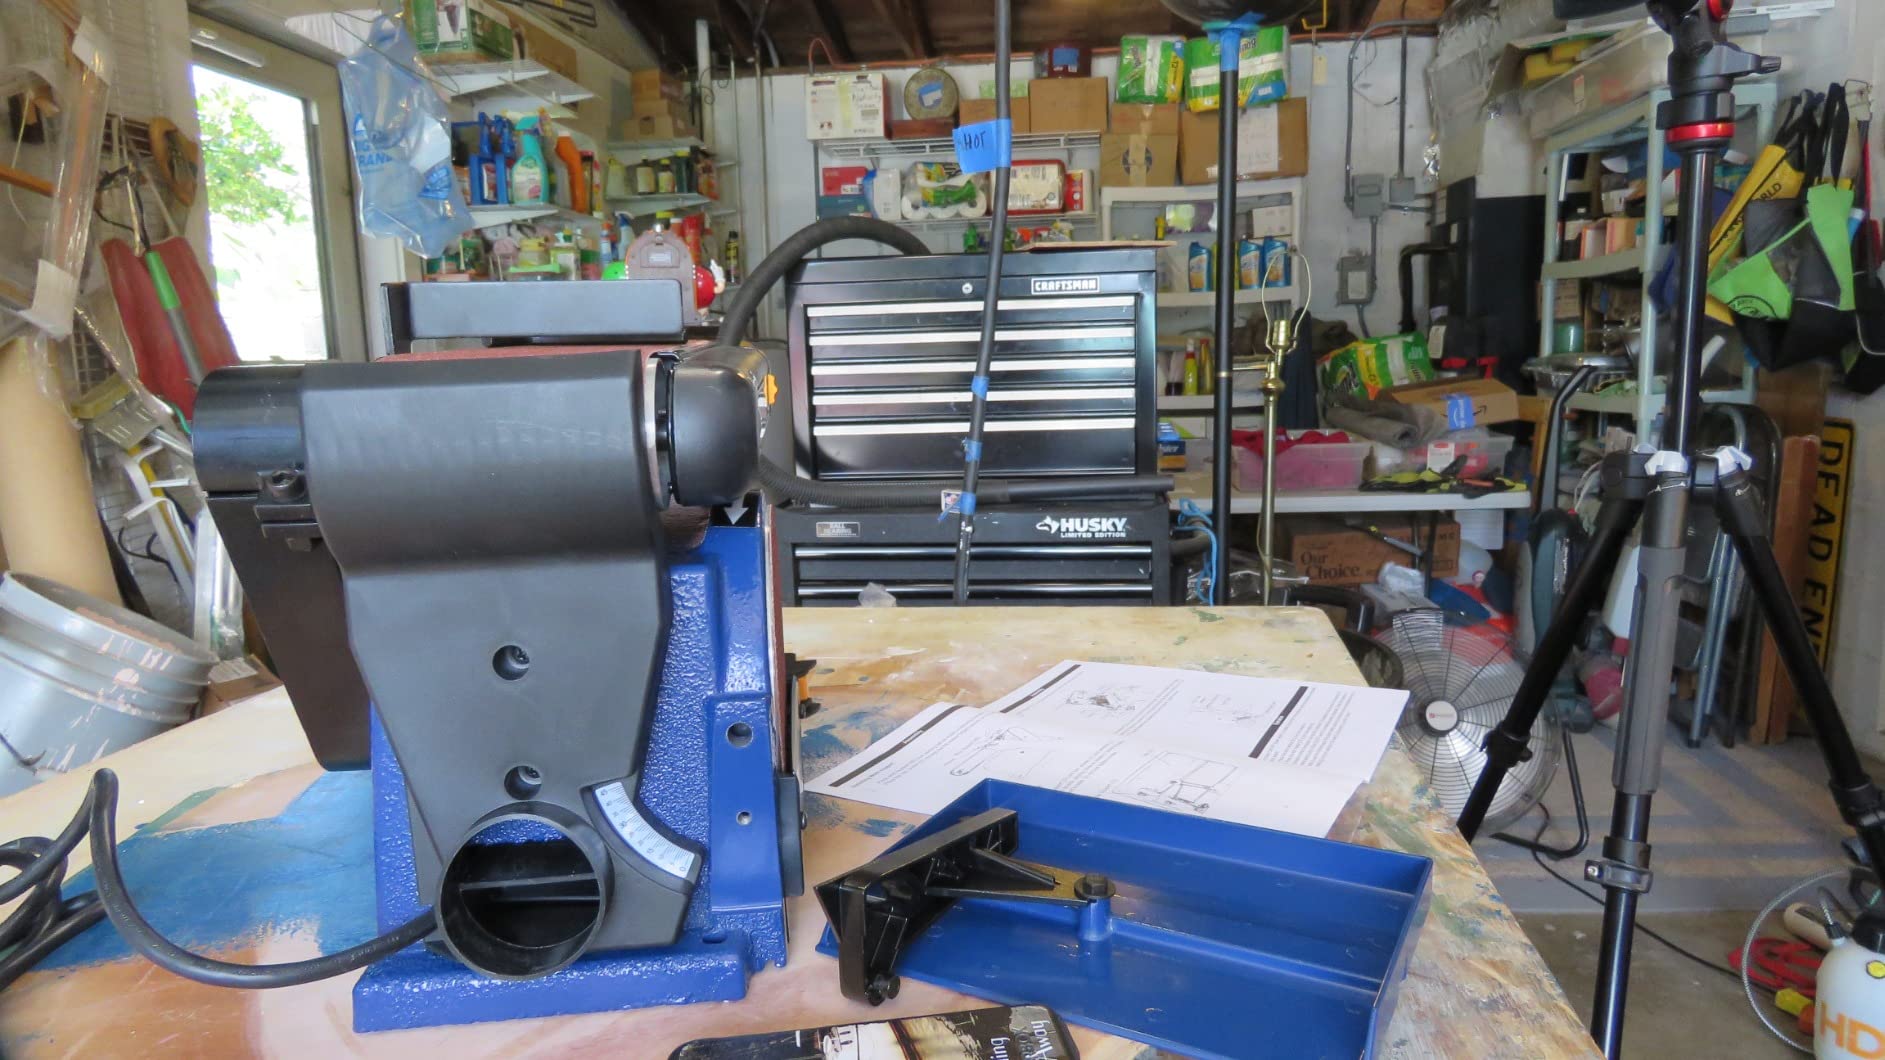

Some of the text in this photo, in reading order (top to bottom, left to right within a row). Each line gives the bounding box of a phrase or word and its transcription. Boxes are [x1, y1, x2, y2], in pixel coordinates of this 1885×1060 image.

[963, 130, 986, 151] HOT
[1035, 279, 1097, 291] CRAFTSMAN
[1060, 517, 1127, 532] HUSKY
[1301, 552, 1328, 565] Our
[1800, 577, 1828, 658] EN
[990, 1037, 1011, 1060] ing
